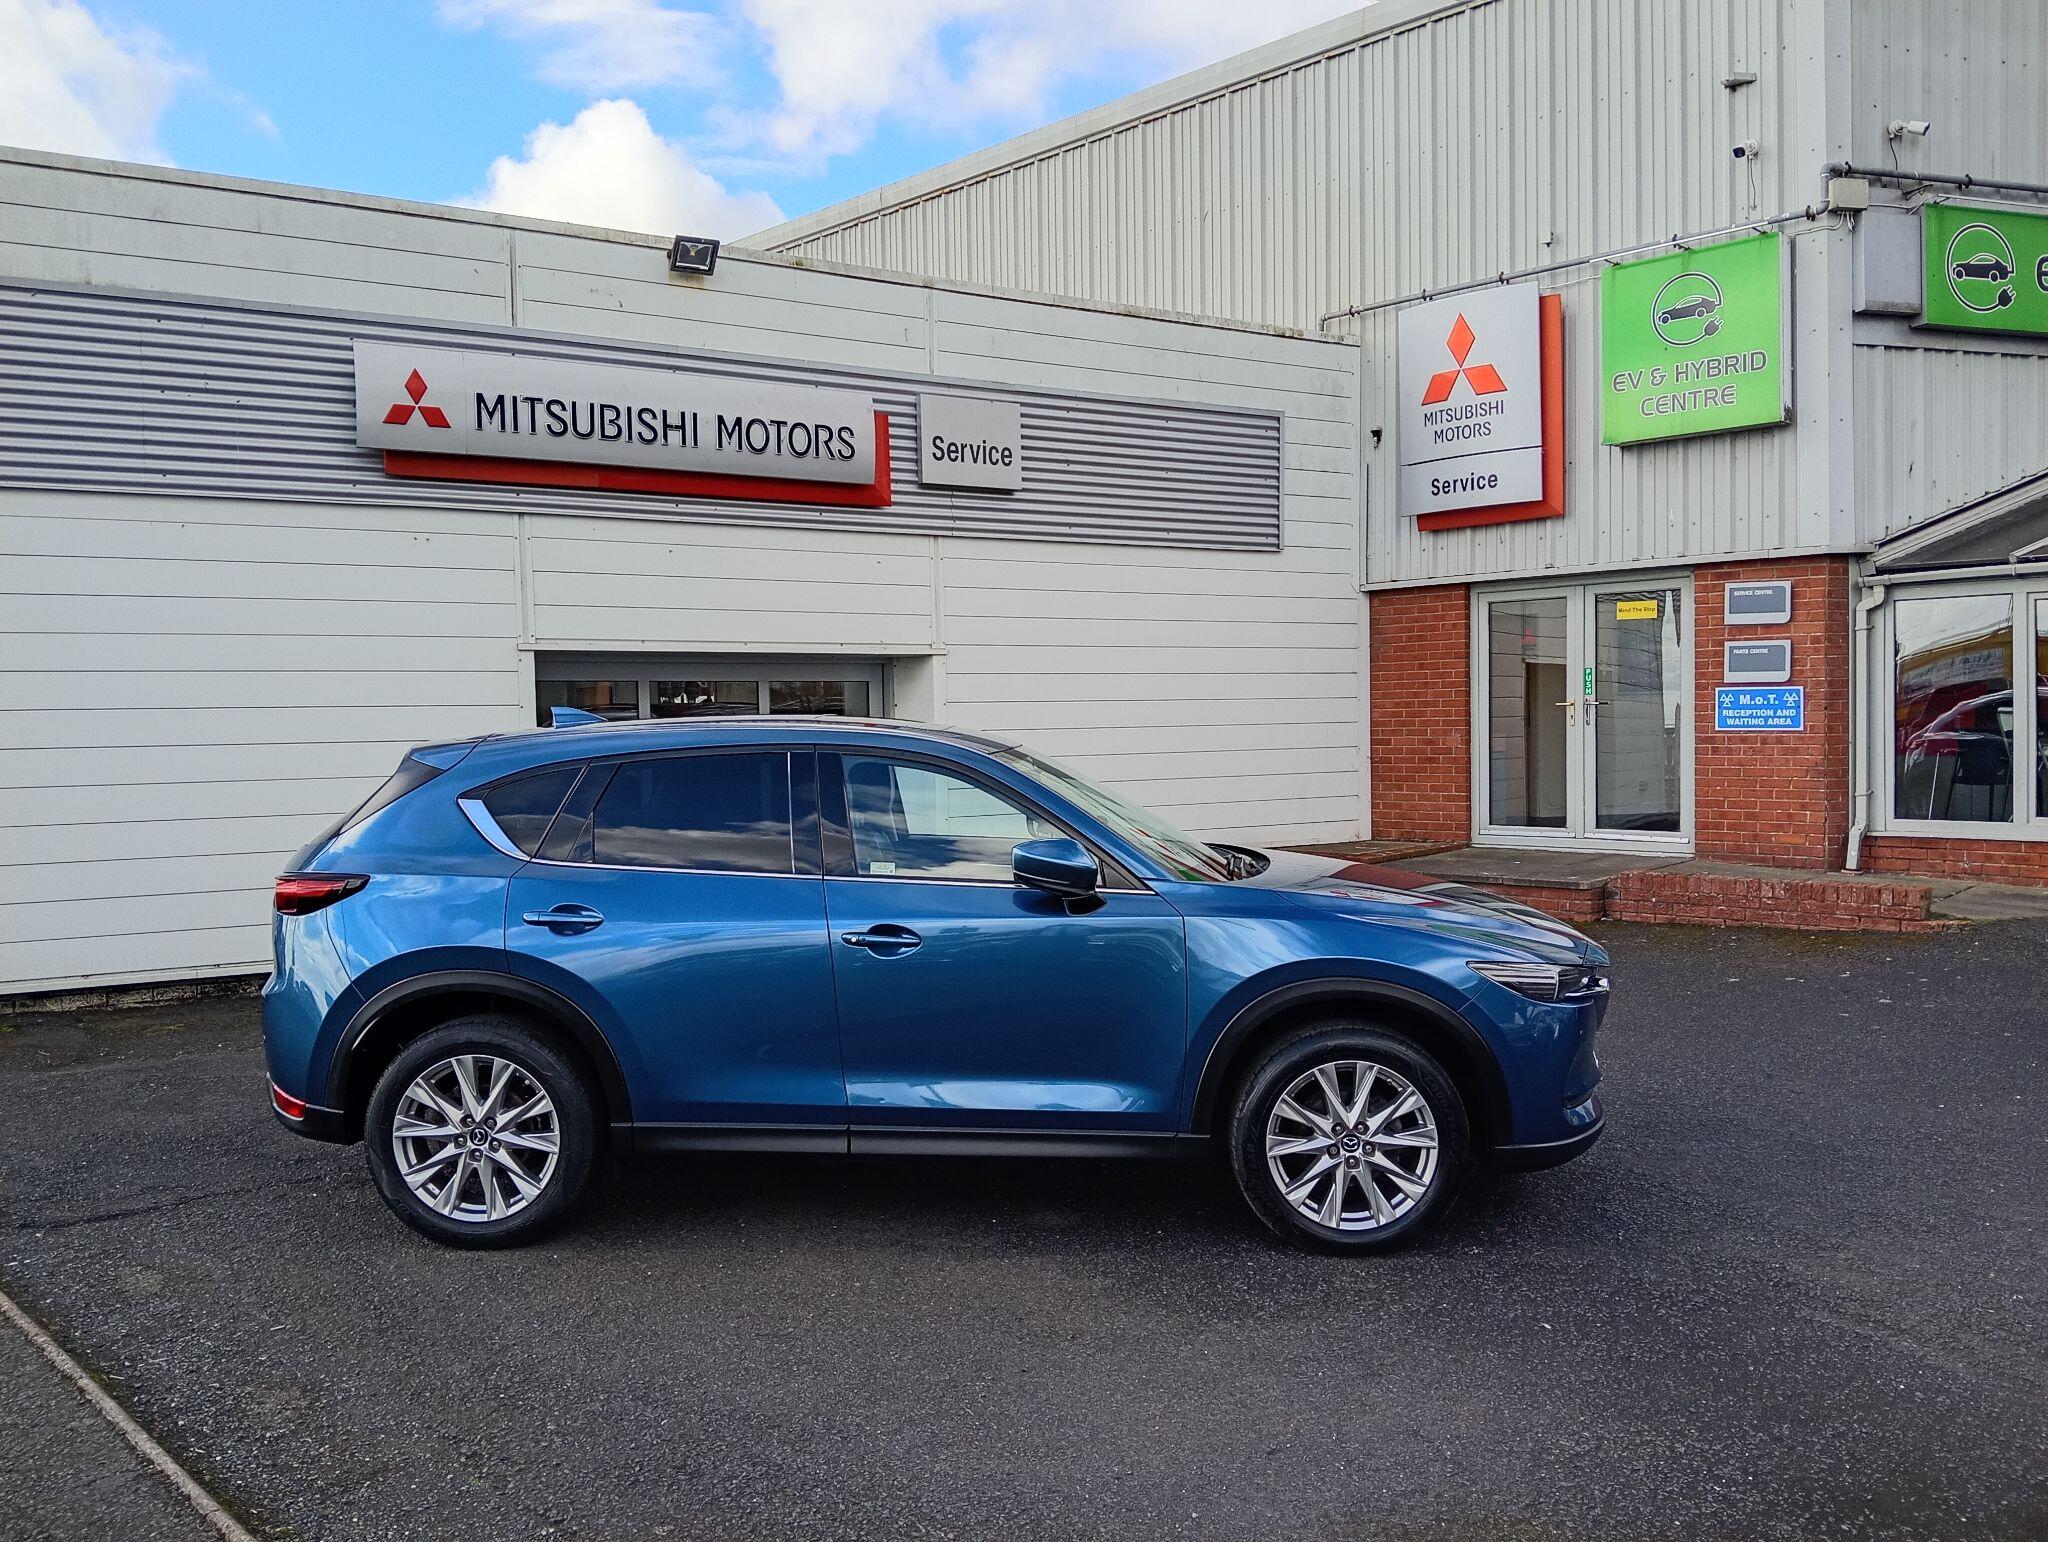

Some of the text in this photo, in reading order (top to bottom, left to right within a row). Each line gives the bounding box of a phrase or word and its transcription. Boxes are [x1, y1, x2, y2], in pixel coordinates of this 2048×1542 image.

[1613, 351, 1768, 393] EV & HYBRID
[1424, 400, 1504, 427] MITSUBISHI
[1640, 384, 1737, 417] CENTRE
[475, 392, 857, 461] MITSUBISHI MOTORS
[1434, 421, 1492, 444] MOTORS
[931, 435, 1013, 467] Service
[1431, 472, 1498, 496] Service
[1585, 668, 1593, 695] PUSH
[1722, 709, 1797, 717] RECEPTION AND
[1739, 694, 1779, 705] M.o.T.
[1726, 718, 1792, 726] WAITING AREA
